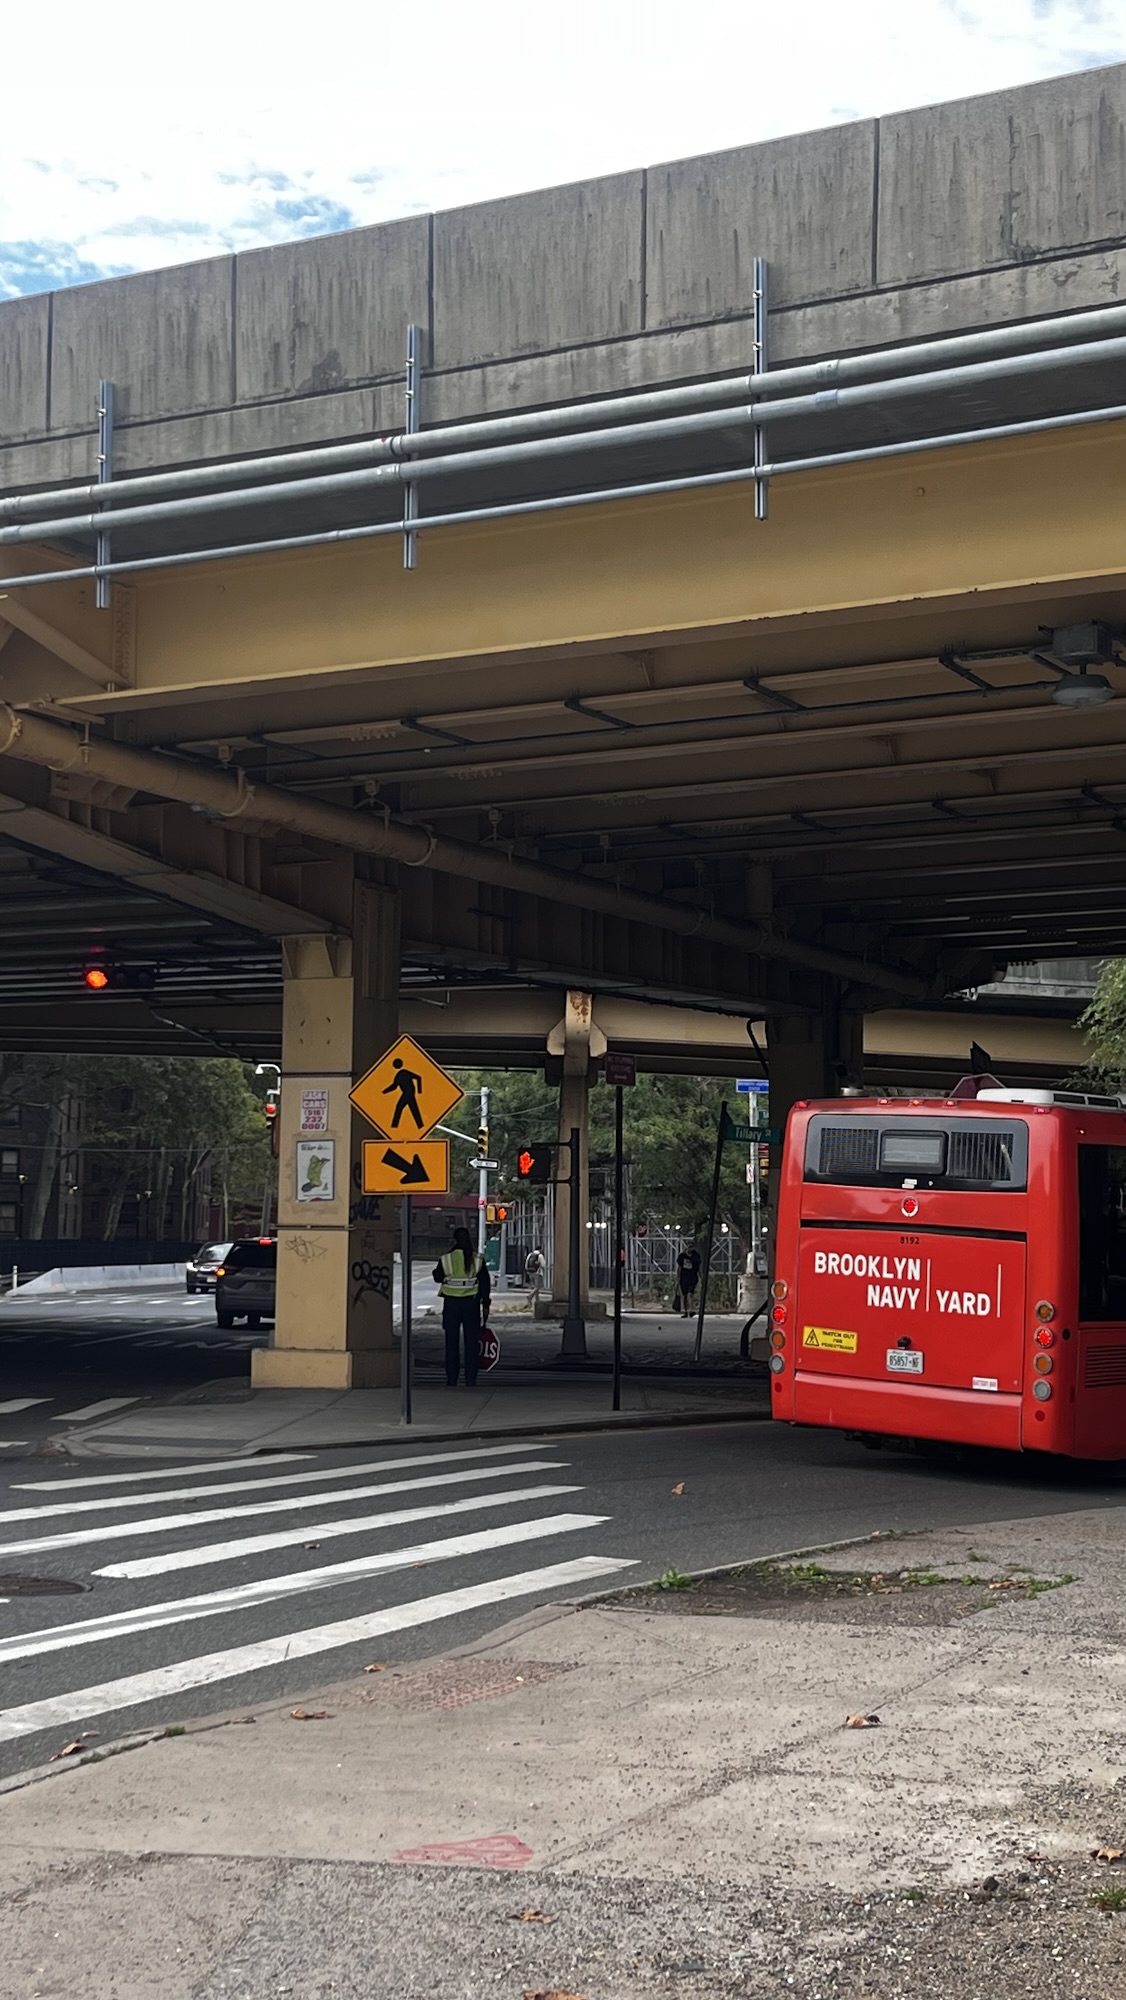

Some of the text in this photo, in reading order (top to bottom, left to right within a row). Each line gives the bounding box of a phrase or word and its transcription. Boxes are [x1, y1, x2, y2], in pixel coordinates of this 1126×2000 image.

[303, 1100, 326, 1108] CARS
[735, 1127, 762, 1141] Tillary
[814, 1251, 921, 1281] BROOKLYN
[867, 1284, 991, 1316] NAVY YARD
